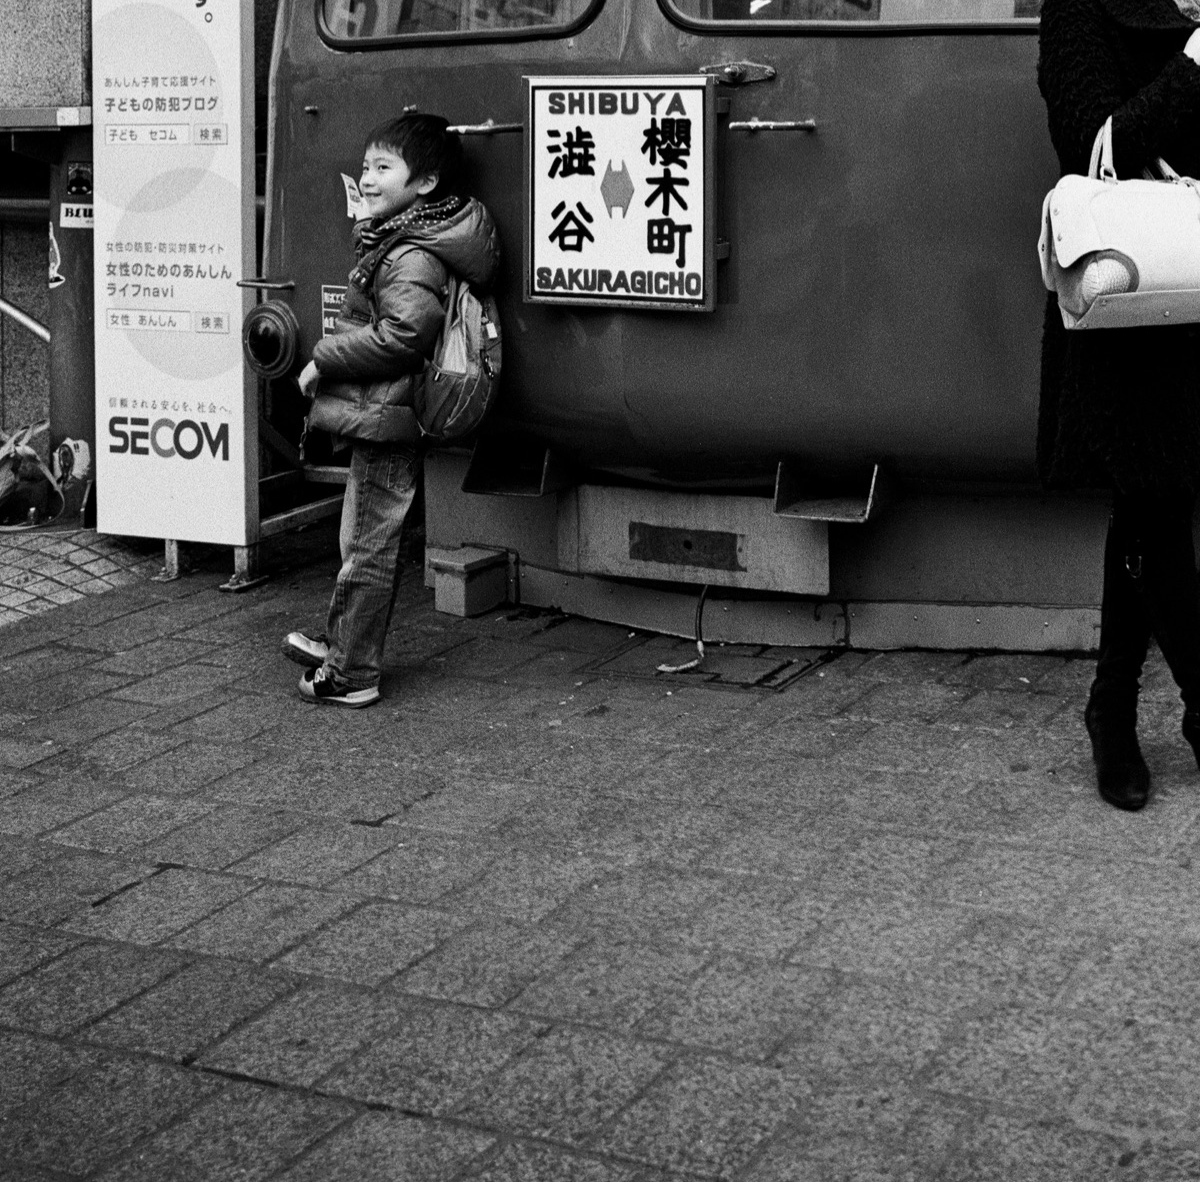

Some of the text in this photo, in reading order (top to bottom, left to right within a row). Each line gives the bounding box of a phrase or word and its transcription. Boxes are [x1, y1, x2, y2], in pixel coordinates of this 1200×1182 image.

[104, 75, 217, 88] あんしん子育て応援サイト
[104, 96, 219, 113] 子どもの防犯ブログ
[548, 91, 687, 116] SHIBUYA
[109, 127, 222, 142] 子ども セコム 検索
[106, 241, 225, 254] 女性の防犯・防災対策サイト
[106, 261, 232, 279] 女性のためのあんしん
[535, 266, 702, 297] SAKURAGICHO
[106, 282, 174, 298] ライフnavi
[110, 314, 223, 329] 女性 あんしん 検索
[108, 415, 230, 461] SECOM
